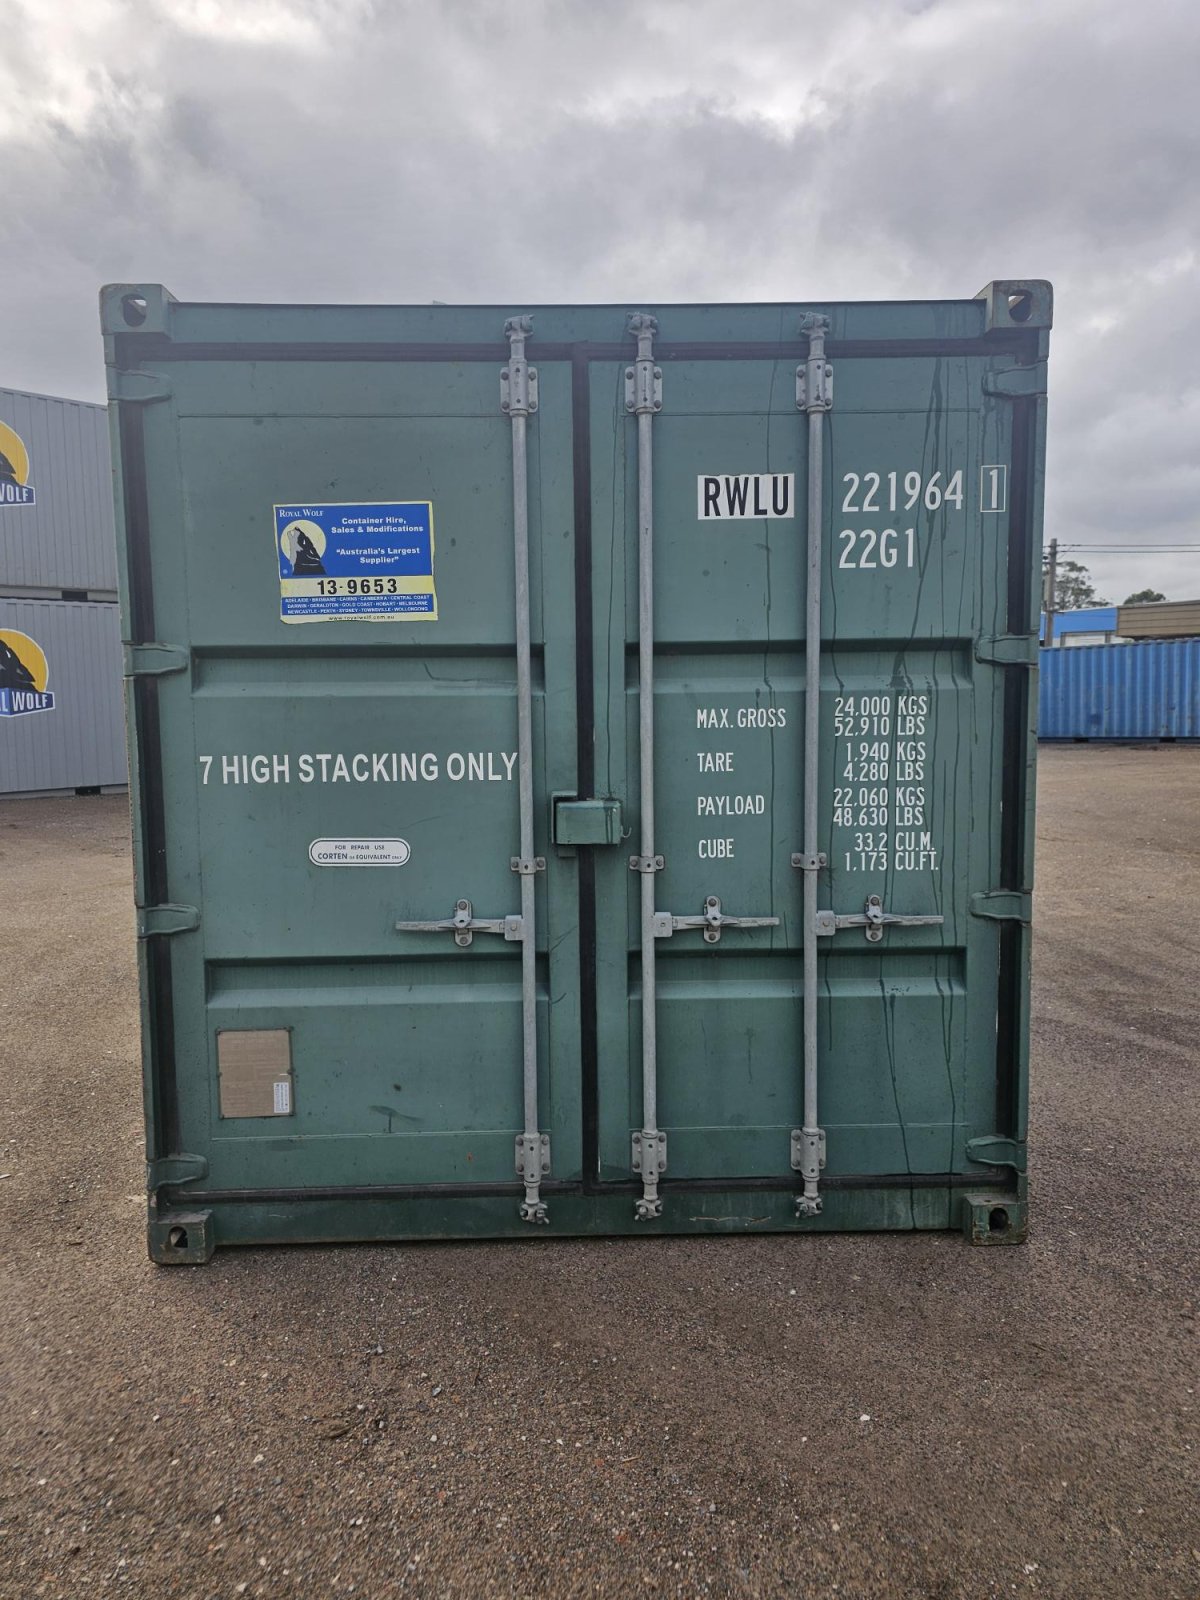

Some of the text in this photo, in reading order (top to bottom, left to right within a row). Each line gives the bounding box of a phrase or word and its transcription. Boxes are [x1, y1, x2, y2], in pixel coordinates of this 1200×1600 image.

[703, 468, 998, 517] RWLU 221964 1
[279, 508, 325, 518] ROYAL WOLF
[341, 516, 407, 525] Container Hire,
[331, 526, 355, 534] Sales
[366, 525, 424, 533] Modifications
[387, 547, 420, 556] Largest
[839, 528, 914, 569] 22G1
[11, 691, 48, 712] WOLF
[834, 695, 928, 717] 24,000 KGS
[696, 708, 787, 729] MAX. GROSS
[834, 716, 926, 737] 52,910 LBS
[846, 741, 926, 762] 1,940 KGS
[199, 752, 518, 785] 7 HIGH STACKING ONLY
[697, 752, 734, 773] TARE
[843, 762, 925, 782] 4,280 LBS
[697, 795, 765, 816] PAYLOAD
[833, 787, 925, 807] 22,060 KGS
[833, 807, 924, 827] 48,630 LBS
[698, 838, 735, 859] CUBE
[854, 831, 935, 852] 33.2 CU.M.
[317, 852, 348, 860] CORTEN
[844, 851, 939, 872] 1,173 CU.FT.
